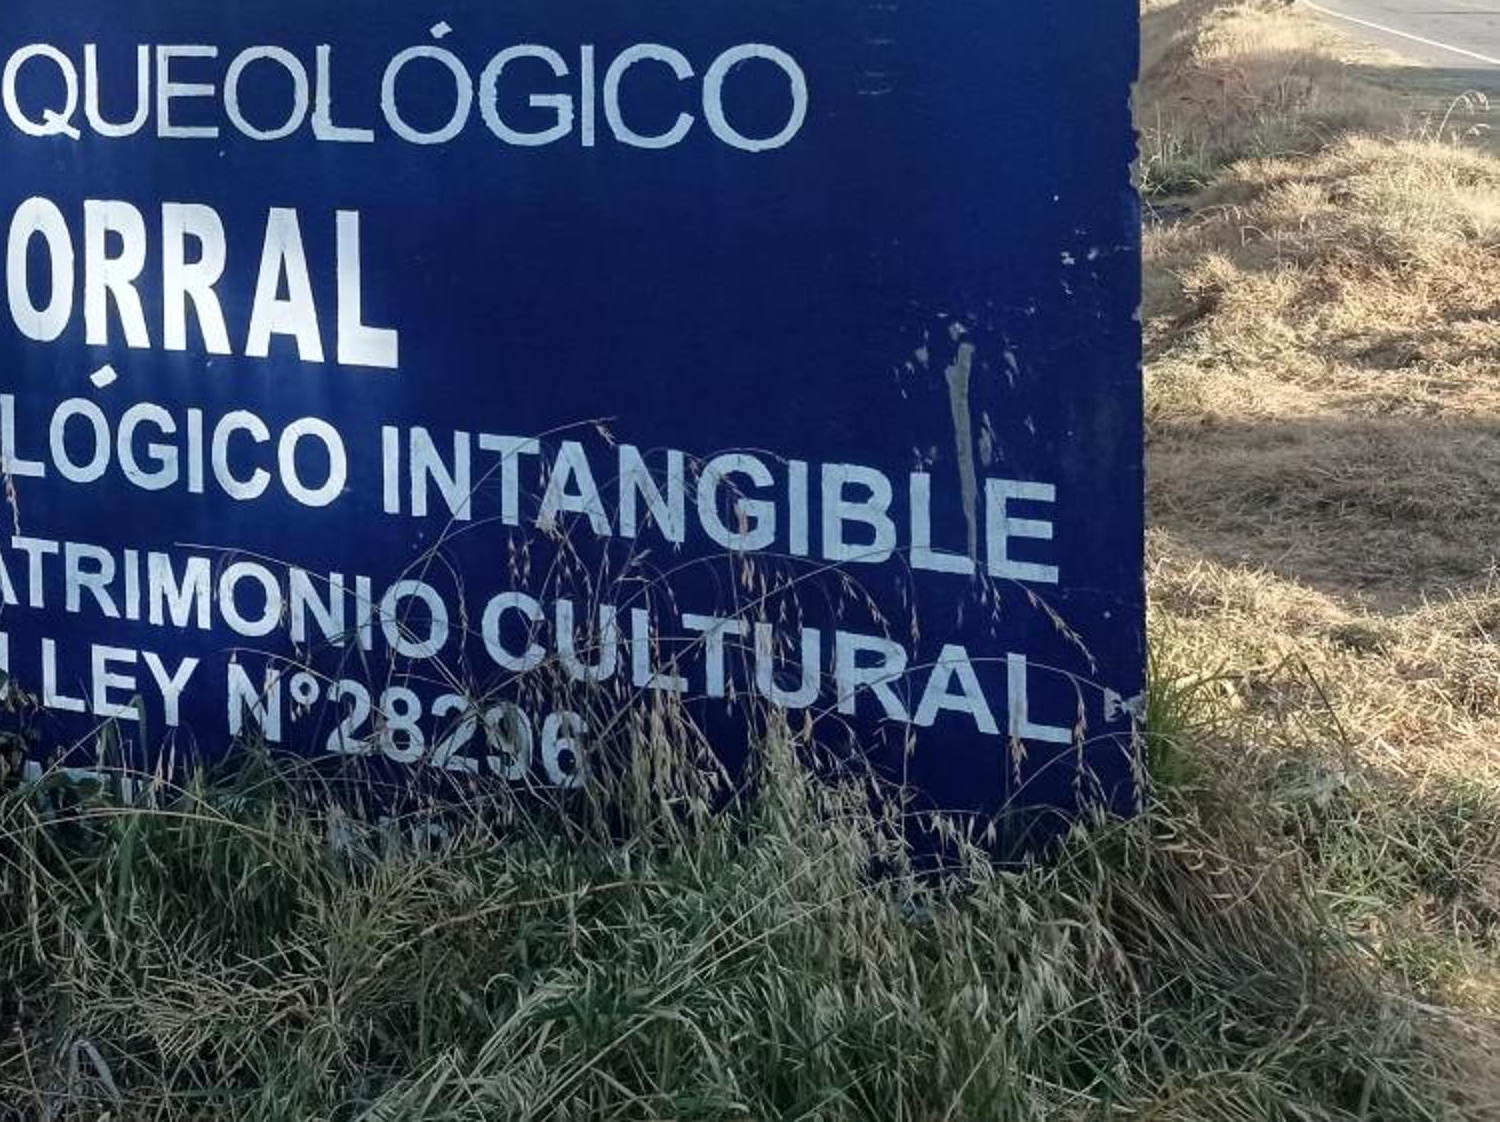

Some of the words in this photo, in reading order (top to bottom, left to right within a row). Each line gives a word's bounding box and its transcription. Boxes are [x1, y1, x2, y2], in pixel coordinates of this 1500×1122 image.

[383, 425, 1060, 583] INTANGIBLE
[43, 638, 198, 727] LEY
[481, 591, 1073, 744] CULTURAL
